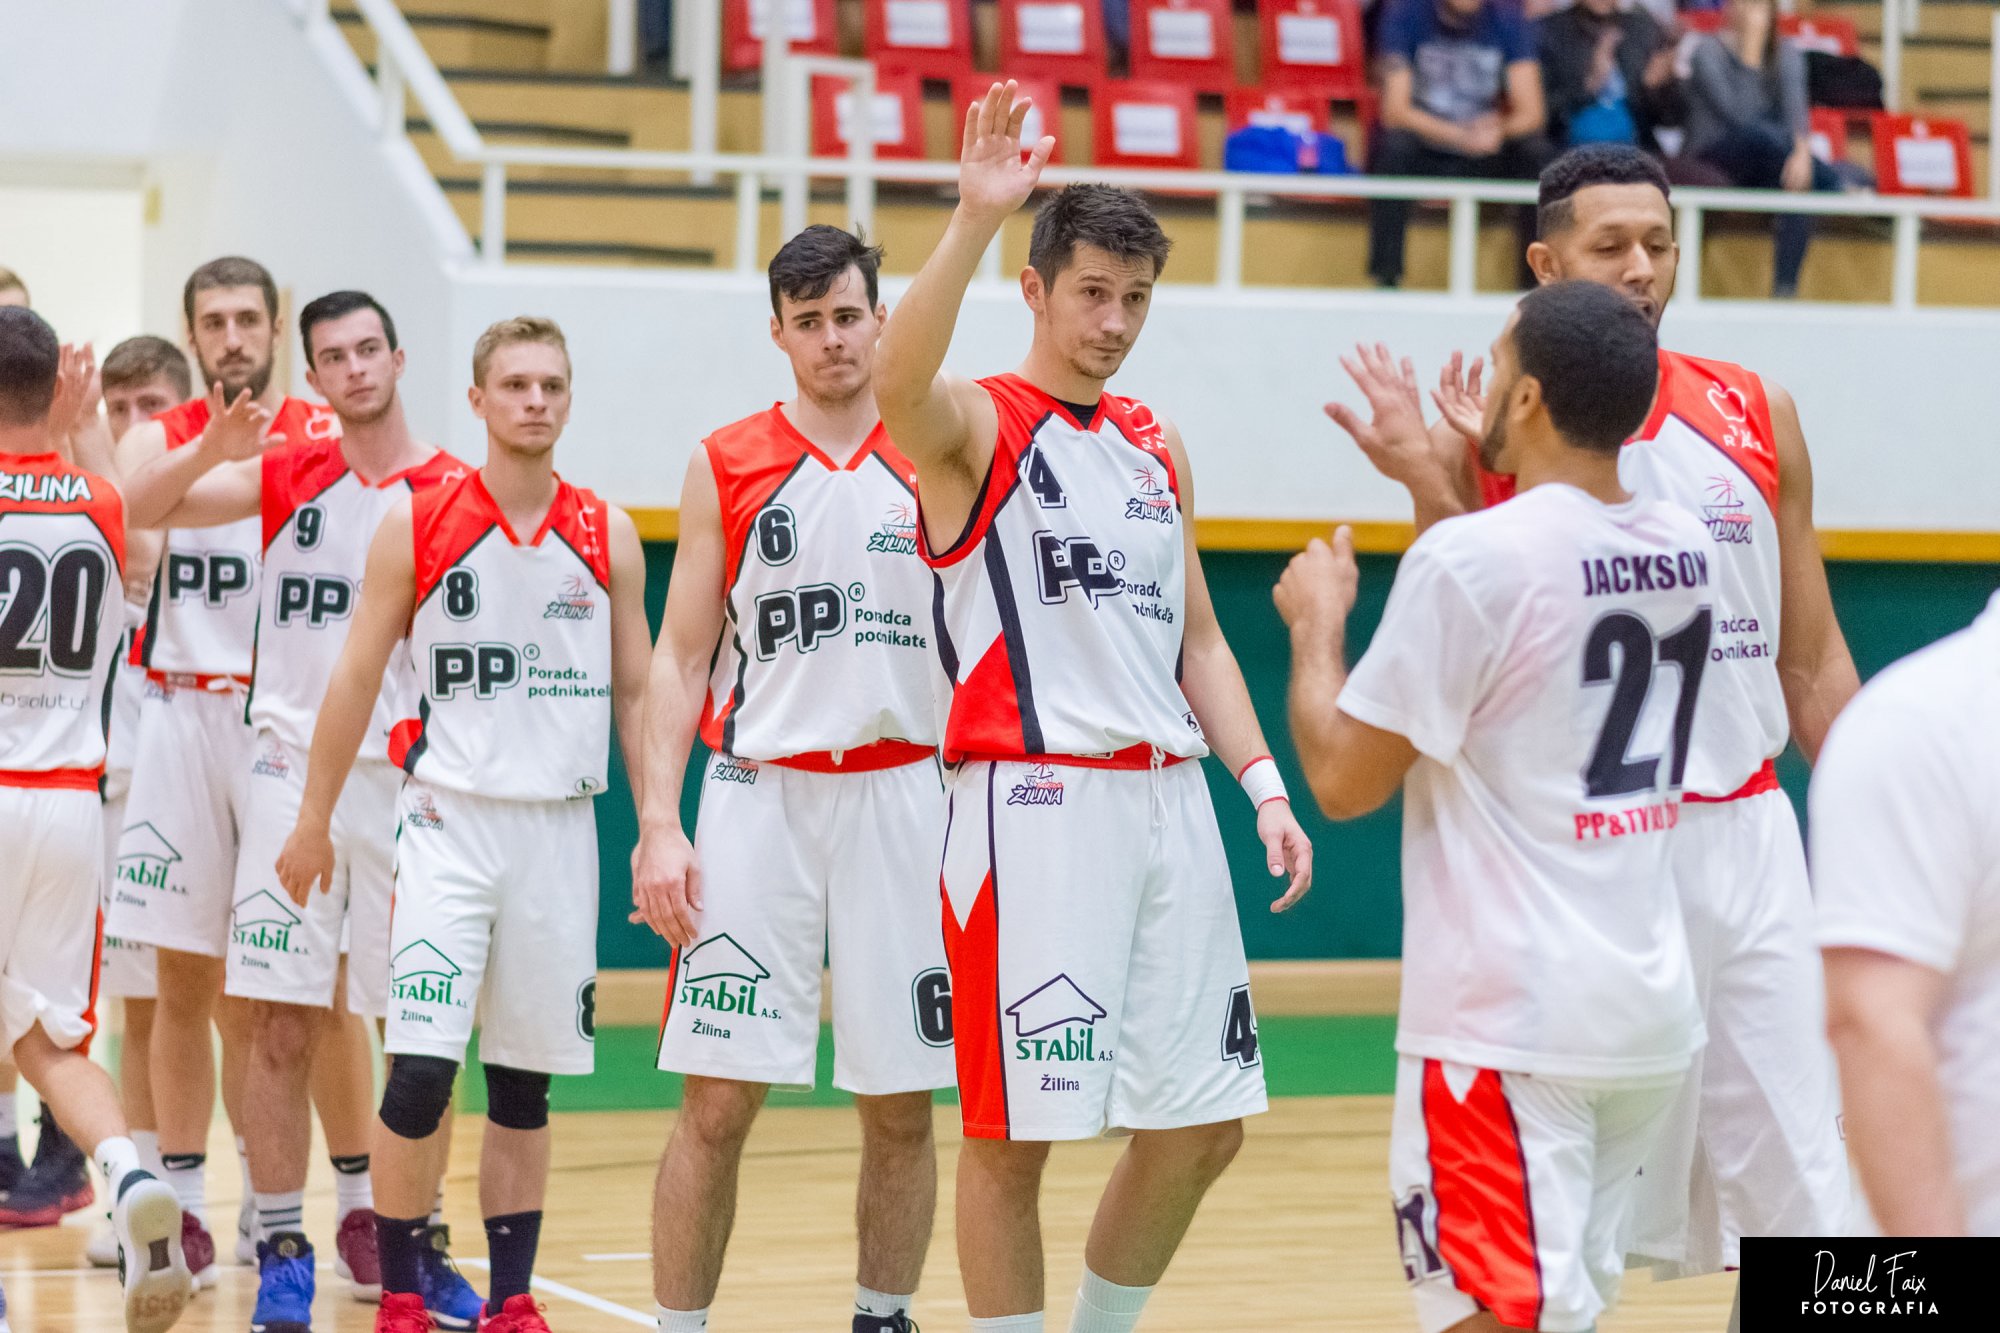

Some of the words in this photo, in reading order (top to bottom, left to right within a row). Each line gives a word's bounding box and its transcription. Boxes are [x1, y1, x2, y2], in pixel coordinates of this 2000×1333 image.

[292, 502, 328, 553] 9
[754, 503, 798, 567] 6
[866, 532, 916, 555] ŽILIN
[168, 552, 252, 608] PP
[441, 565, 481, 622] 8
[1033, 530, 1124, 610] PP
[1582, 551, 1708, 597] JACKSON
[0, 542, 111, 677] 20
[274, 571, 354, 629] PP
[755, 583, 847, 662] PP
[430, 642, 521, 700] PP
[528, 666, 588, 680] Poradca
[1580, 604, 1713, 801] 21
[1007, 784, 1064, 806] ŽILINA
[232, 926, 289, 953] STAbil
[391, 977, 453, 1006] STAbil
[401, 1009, 434, 1023] Žilina
[680, 981, 757, 1016] STAbil
[761, 1008, 782, 1019] A.S.
[912, 967, 956, 1048] 6
[692, 1018, 732, 1039] Žilina
[1016, 1027, 1096, 1061] STAbil
[1221, 983, 1260, 1070] 4
[1041, 1073, 1080, 1091] Žilina
